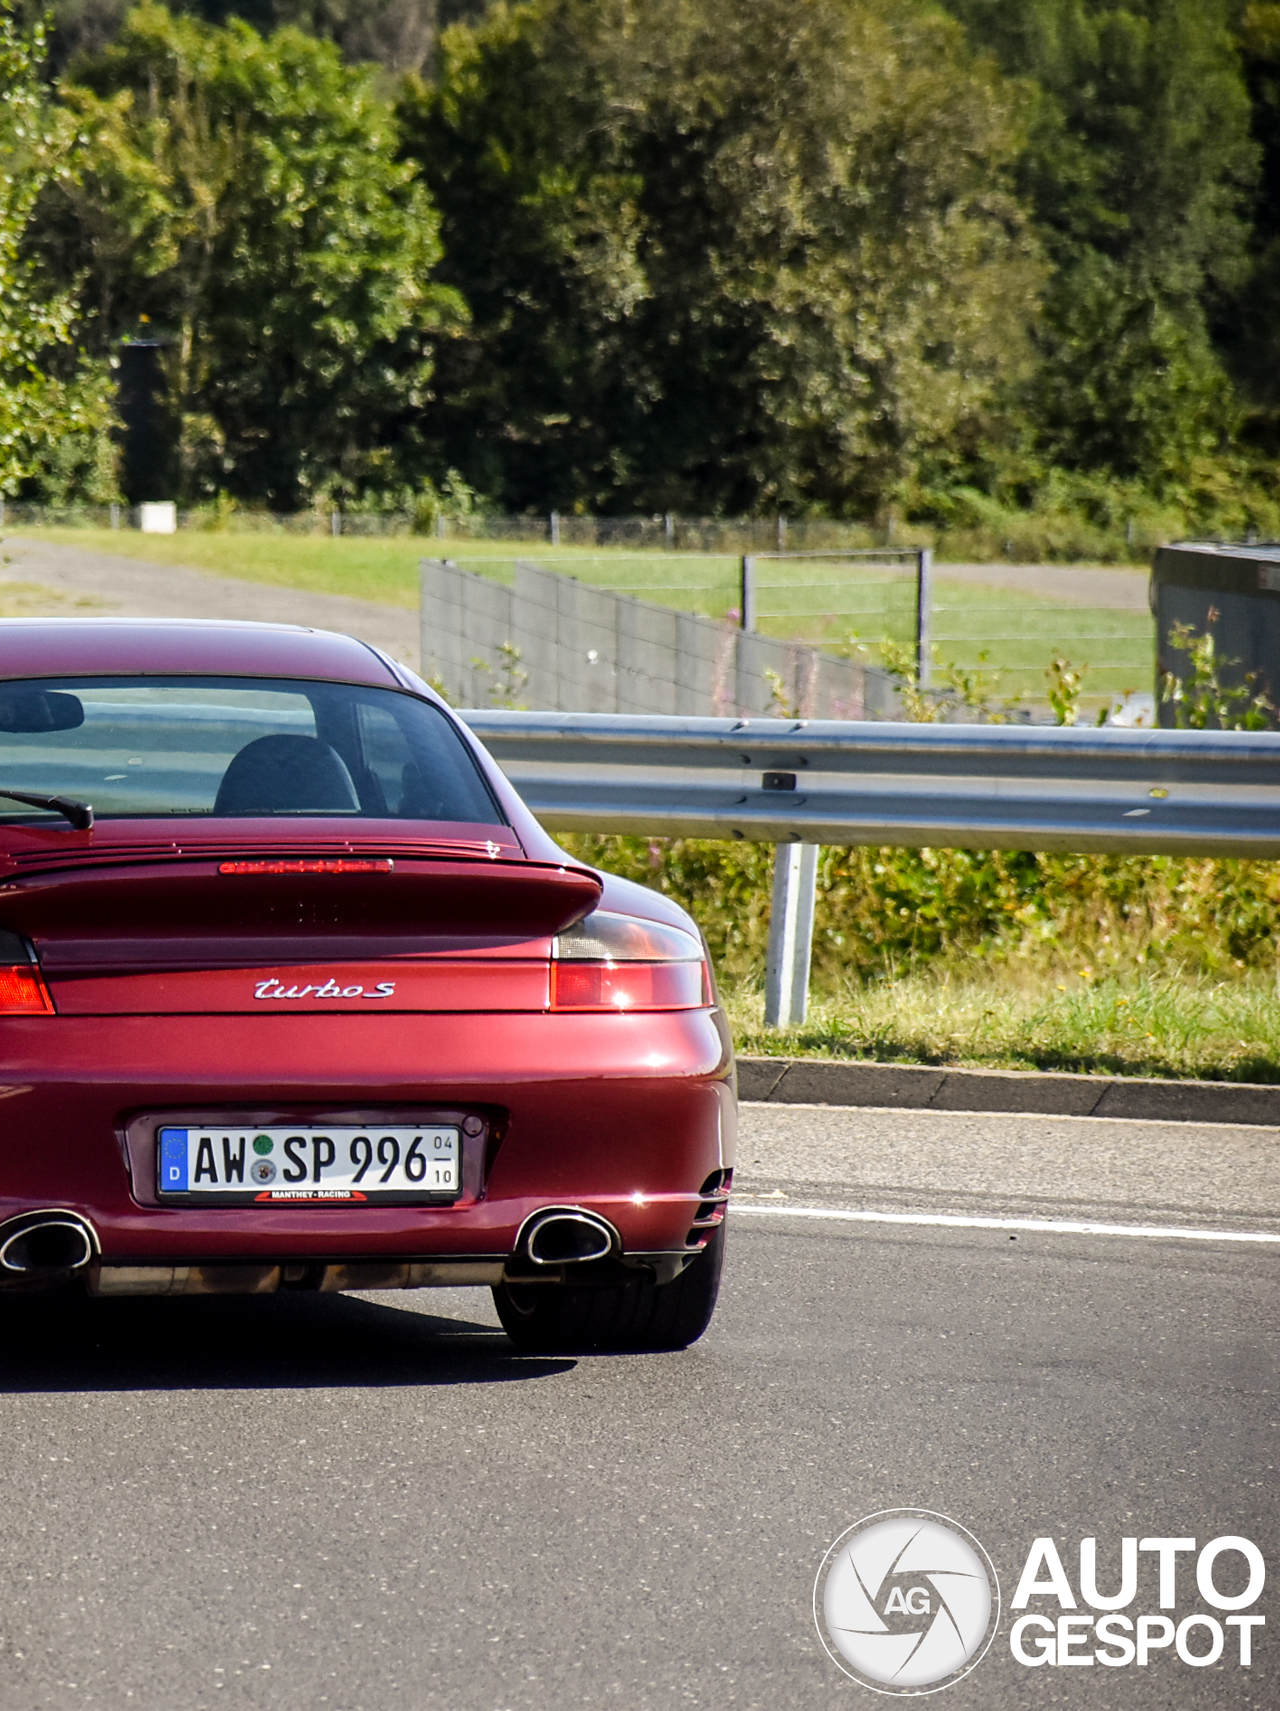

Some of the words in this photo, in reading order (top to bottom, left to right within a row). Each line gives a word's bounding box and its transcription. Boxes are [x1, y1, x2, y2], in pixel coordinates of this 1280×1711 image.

[253, 978, 363, 999] turbo
[434, 1136, 452, 1149] 04
[194, 1137, 246, 1183] AW
[282, 1136, 336, 1183] SP
[349, 1136, 428, 1183] 996
[169, 1167, 180, 1181] D
[435, 1170, 452, 1183] 10
